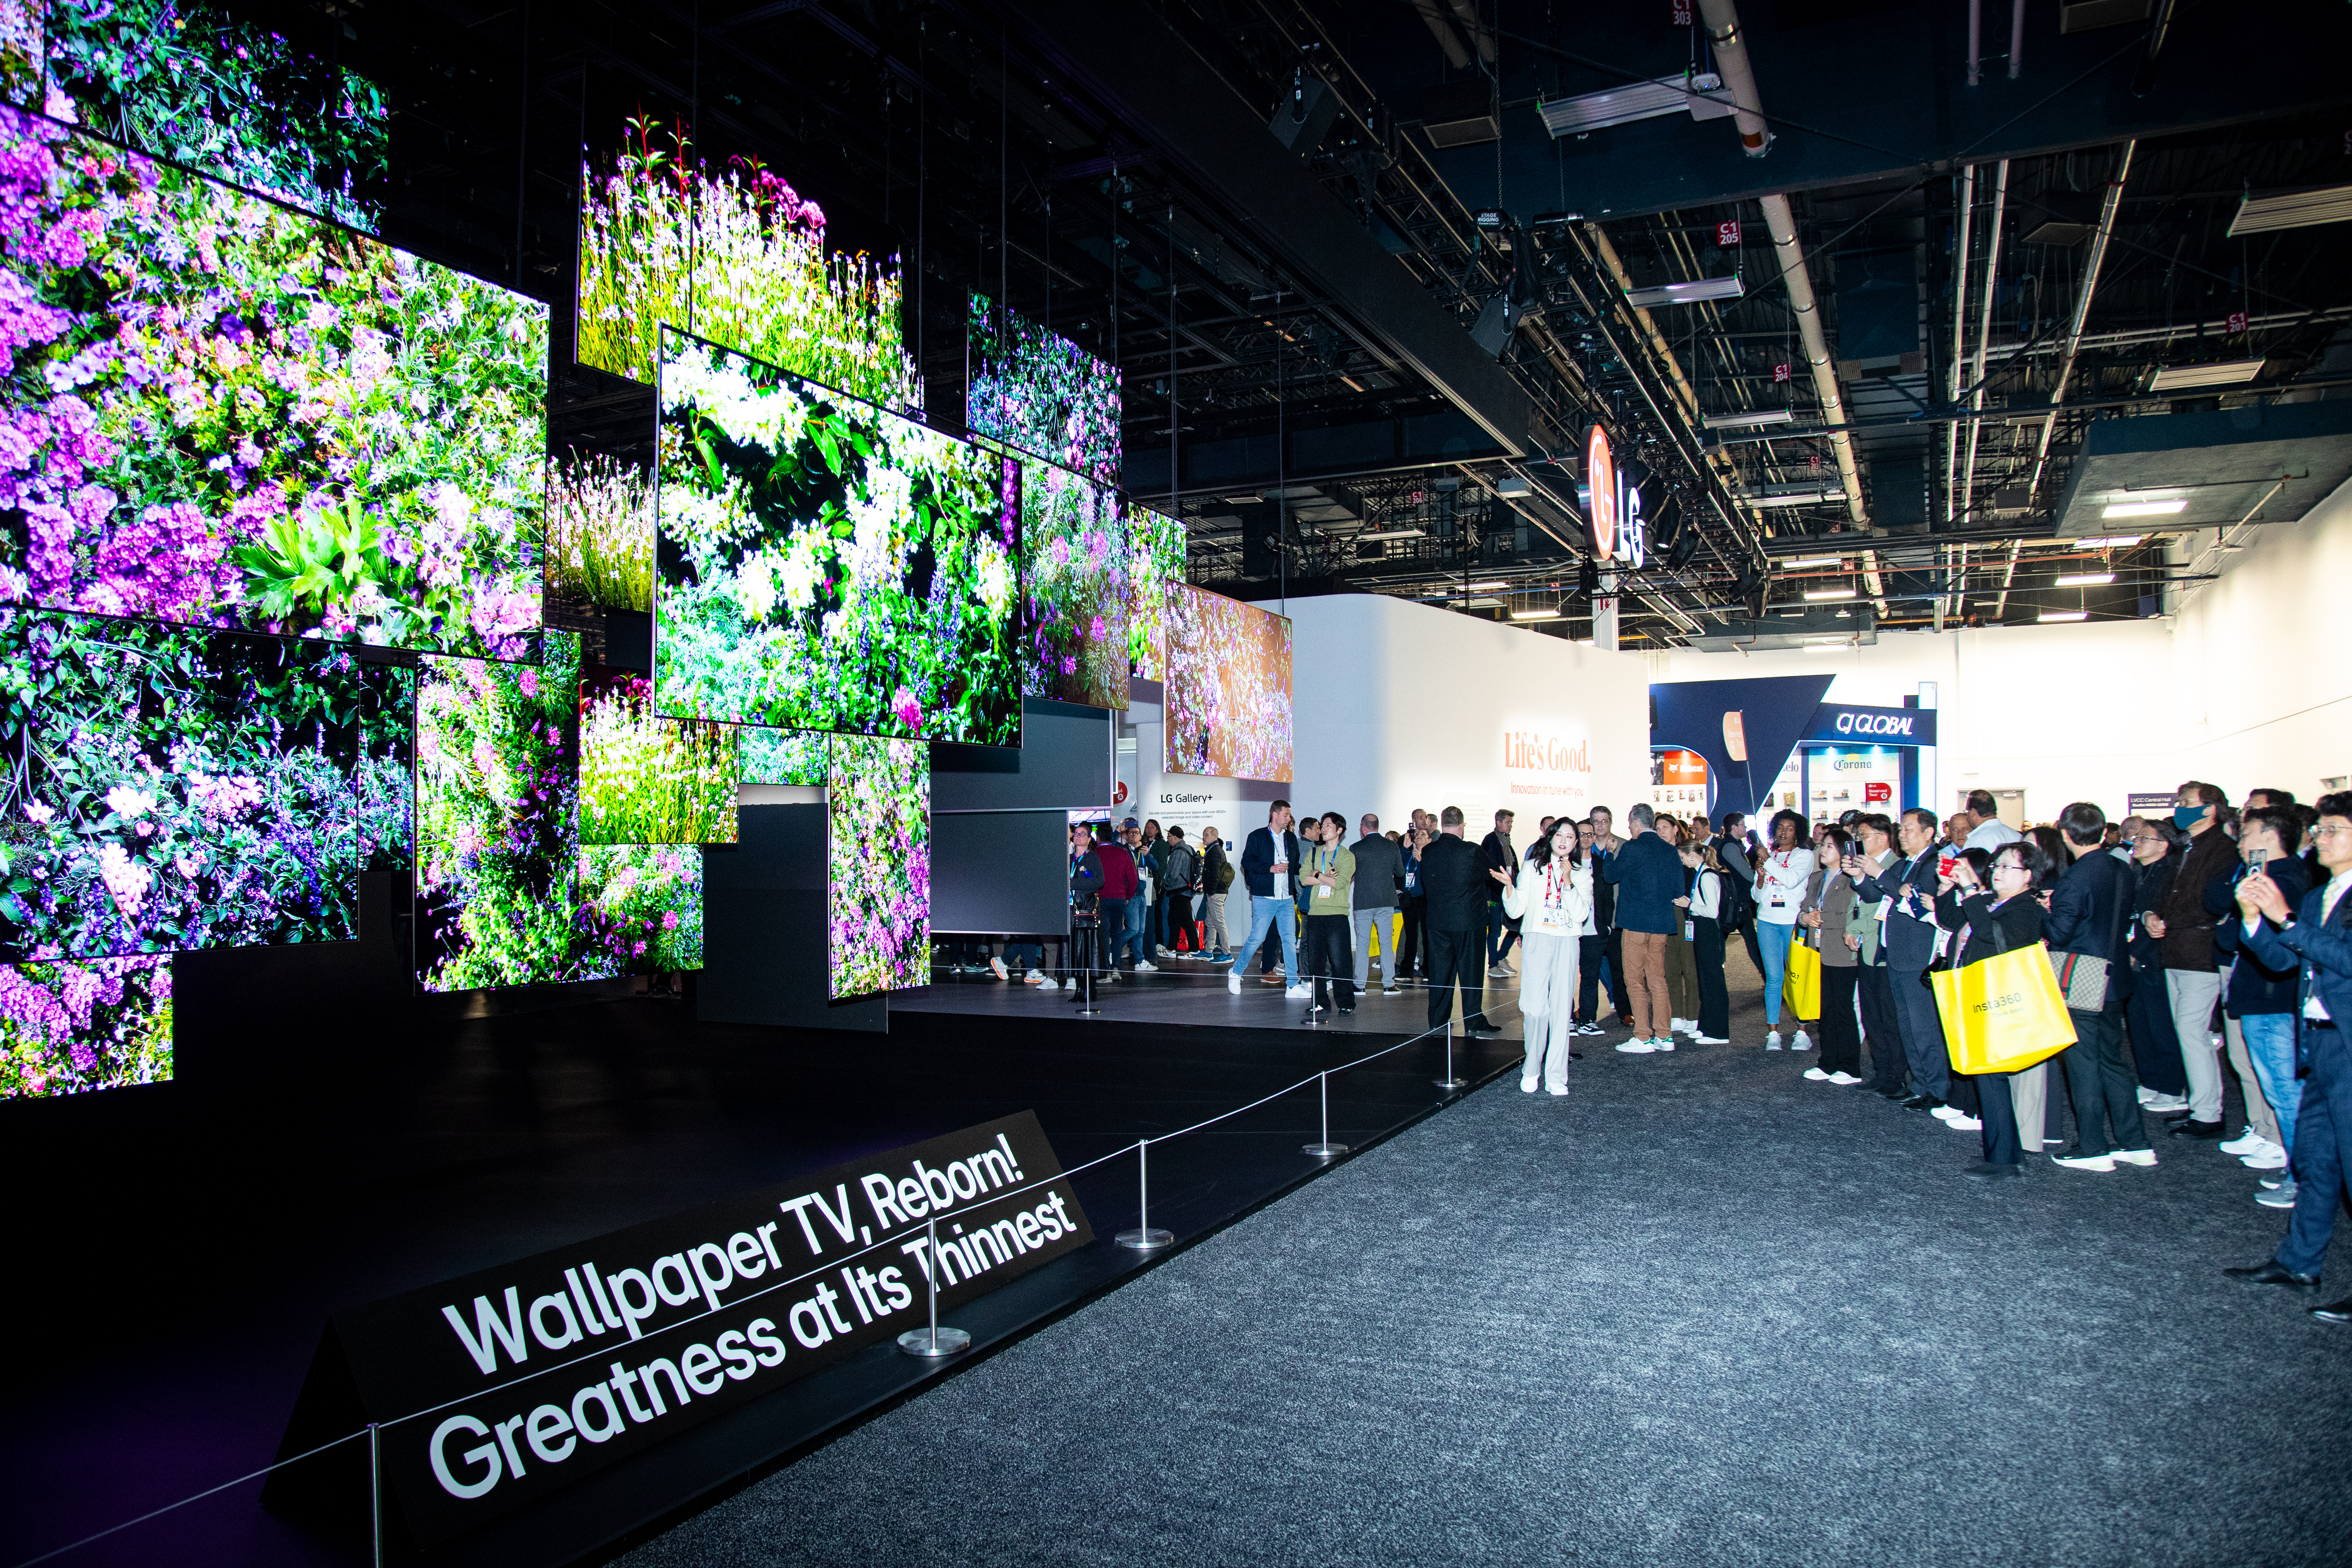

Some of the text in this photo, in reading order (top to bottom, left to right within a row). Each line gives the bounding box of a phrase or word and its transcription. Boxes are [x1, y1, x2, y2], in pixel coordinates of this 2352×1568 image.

[1674, 11, 1691, 24] 303
[1720, 222, 1736, 233] C1
[1720, 233, 1739, 245] 205
[2229, 313, 2244, 323] C1
[2230, 322, 2245, 332] 201
[1776, 364, 1787, 373] C1
[1776, 372, 1788, 382] 204
[1617, 469, 1645, 568] LG
[1855, 714, 1914, 735] GLOBAL
[1505, 731, 1591, 773] Life's Good.
[1783, 762, 1799, 772] elo
[1833, 760, 1872, 772] Corona
[1511, 781, 1583, 798] Innovation in tune with you
[1161, 793, 1213, 804] LG Gallery+
[1973, 992, 2021, 1013] Insta360
[442, 1133, 1026, 1375] Wallpaper TV, Reborn!
[429, 1191, 1077, 1499] Greatness at Its Thinnest
